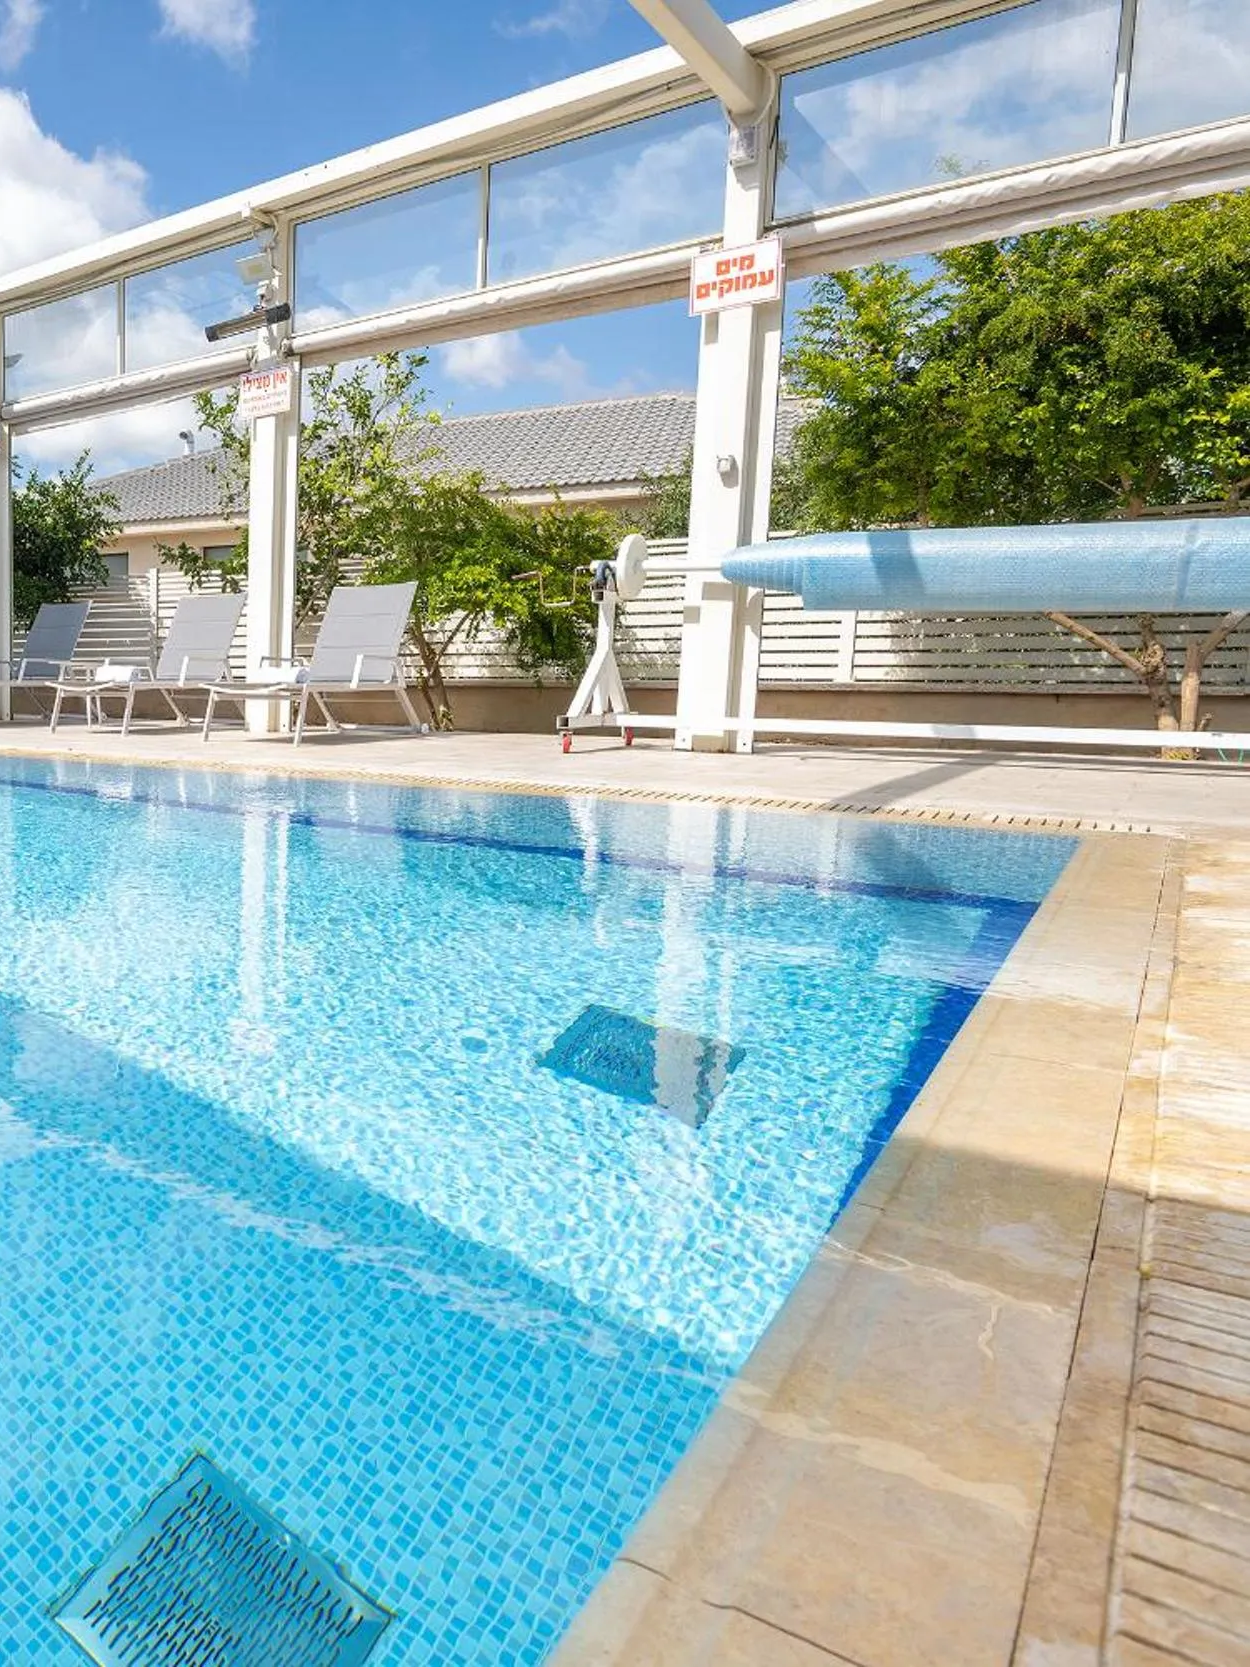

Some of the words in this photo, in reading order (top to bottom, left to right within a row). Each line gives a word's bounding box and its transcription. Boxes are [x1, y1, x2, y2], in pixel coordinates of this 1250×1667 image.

[716, 253, 755, 276] מים
[696, 270, 774, 299] עמוקים
[273, 371, 287, 389] אין
